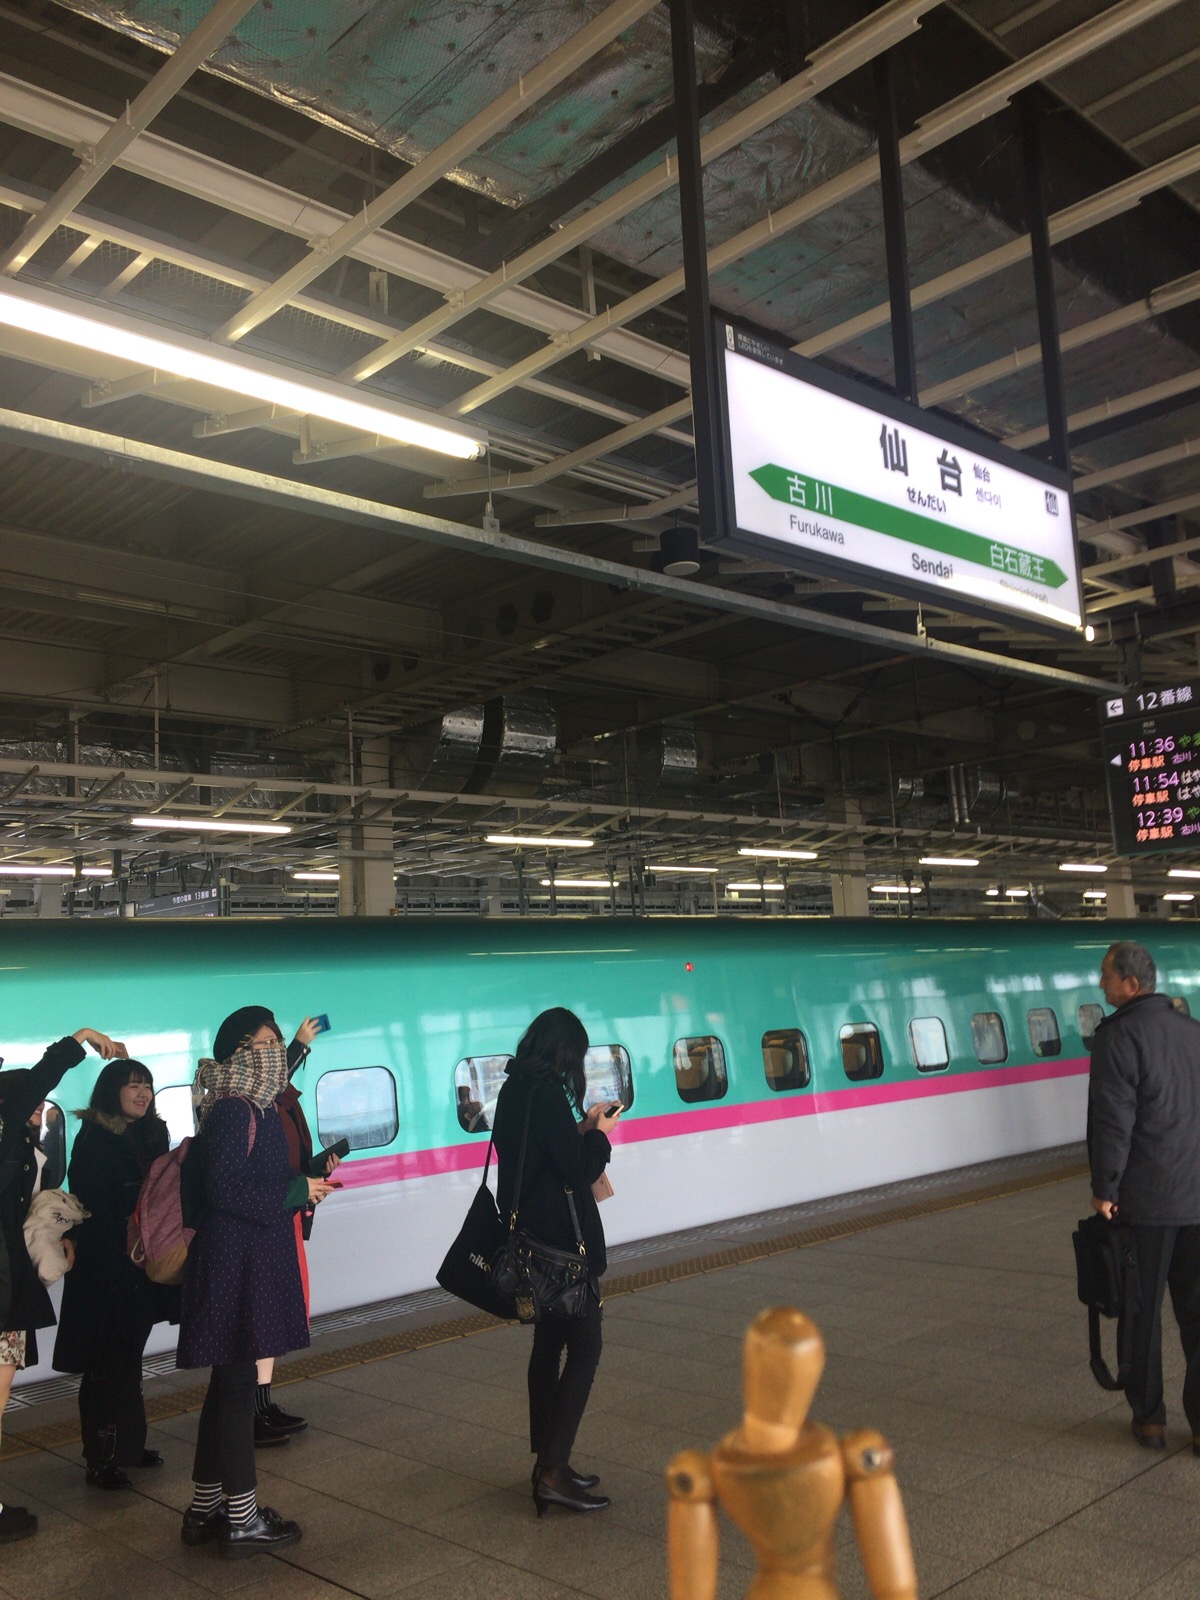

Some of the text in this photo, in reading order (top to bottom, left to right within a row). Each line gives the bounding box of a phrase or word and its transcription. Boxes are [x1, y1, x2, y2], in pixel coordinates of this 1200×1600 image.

[879, 423, 963, 498] 仙台
[973, 463, 991, 483] 仙台
[786, 474, 834, 516] 古川
[906, 486, 947, 513] せんだい
[975, 487, 1002, 509] 센다이
[789, 514, 845, 546] Furukawa
[911, 552, 954, 580] Sendai
[990, 543, 1047, 584] 白石蔵王
[1136, 686, 1193, 712] 12番線
[1129, 735, 1176, 758] 11:36
[1127, 754, 1166, 773] 停車駅
[1133, 771, 1180, 793] 11:54
[1131, 789, 1170, 808] 停車駅
[1136, 806, 1184, 828] 12:39
[1135, 825, 1175, 843] 停車駅
